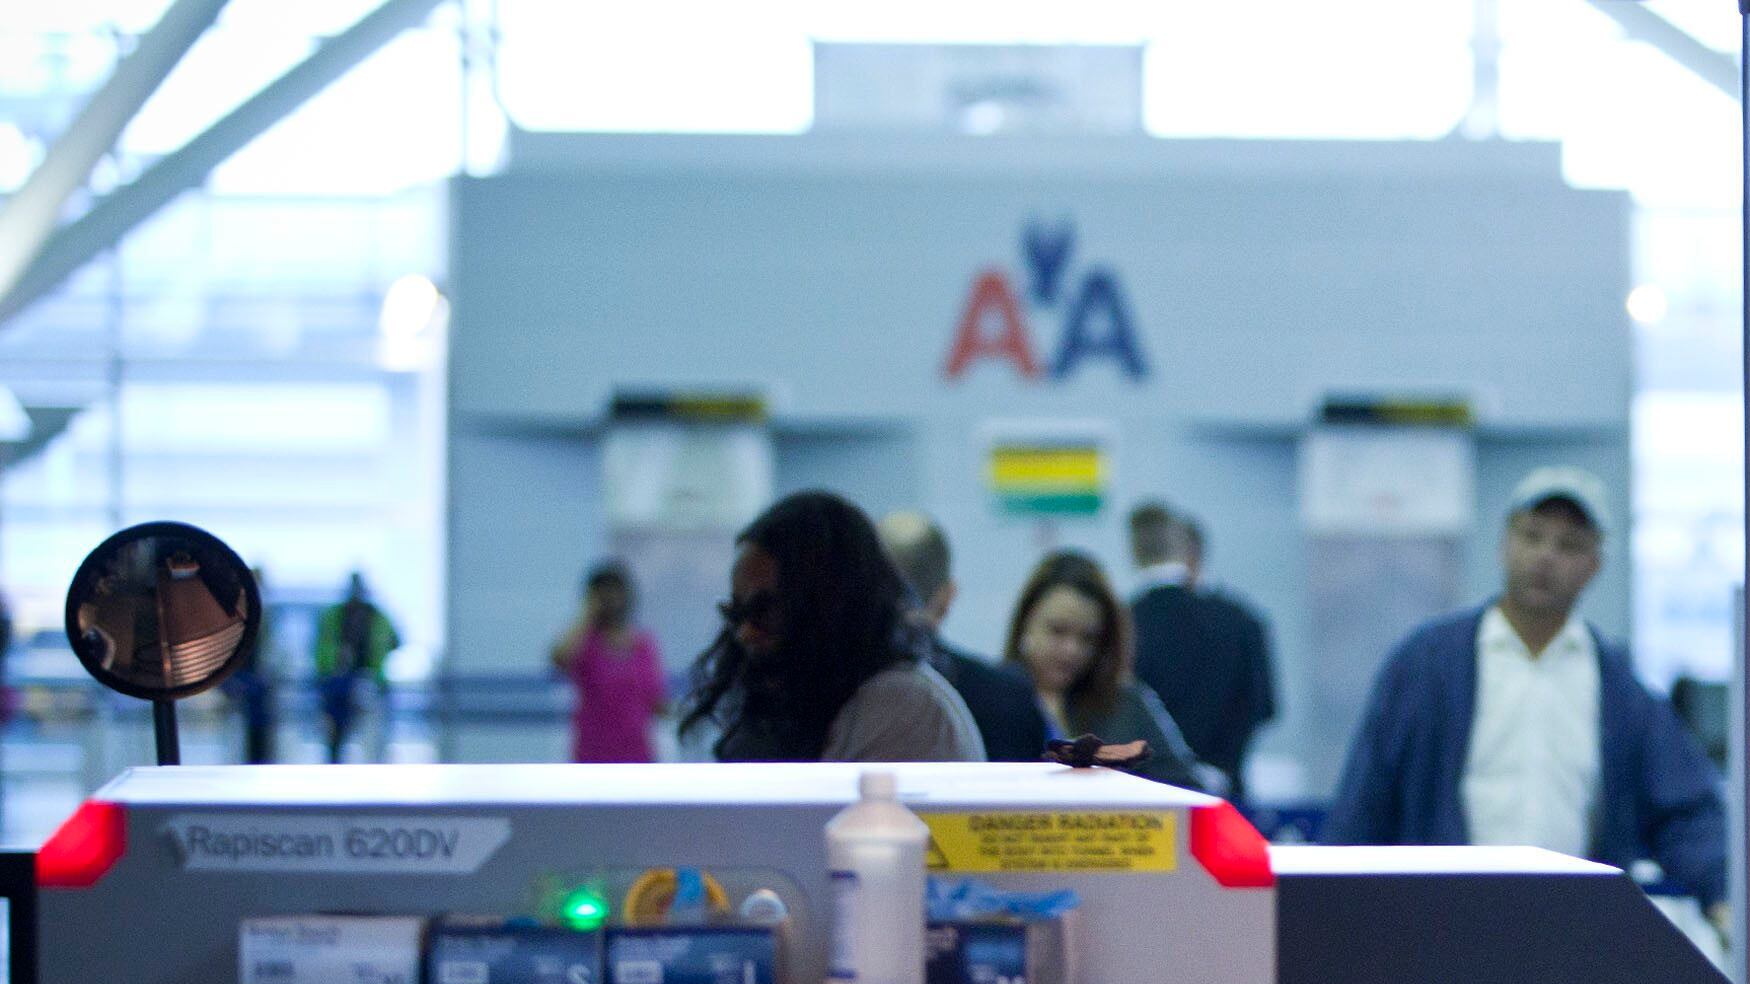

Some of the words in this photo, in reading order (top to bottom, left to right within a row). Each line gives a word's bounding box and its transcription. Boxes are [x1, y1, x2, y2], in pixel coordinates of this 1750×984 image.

[969, 814, 1051, 830] DANGER
[1057, 814, 1163, 830] RADIATION
[186, 825, 334, 861] Rapiscan
[346, 826, 460, 859] 620DV
